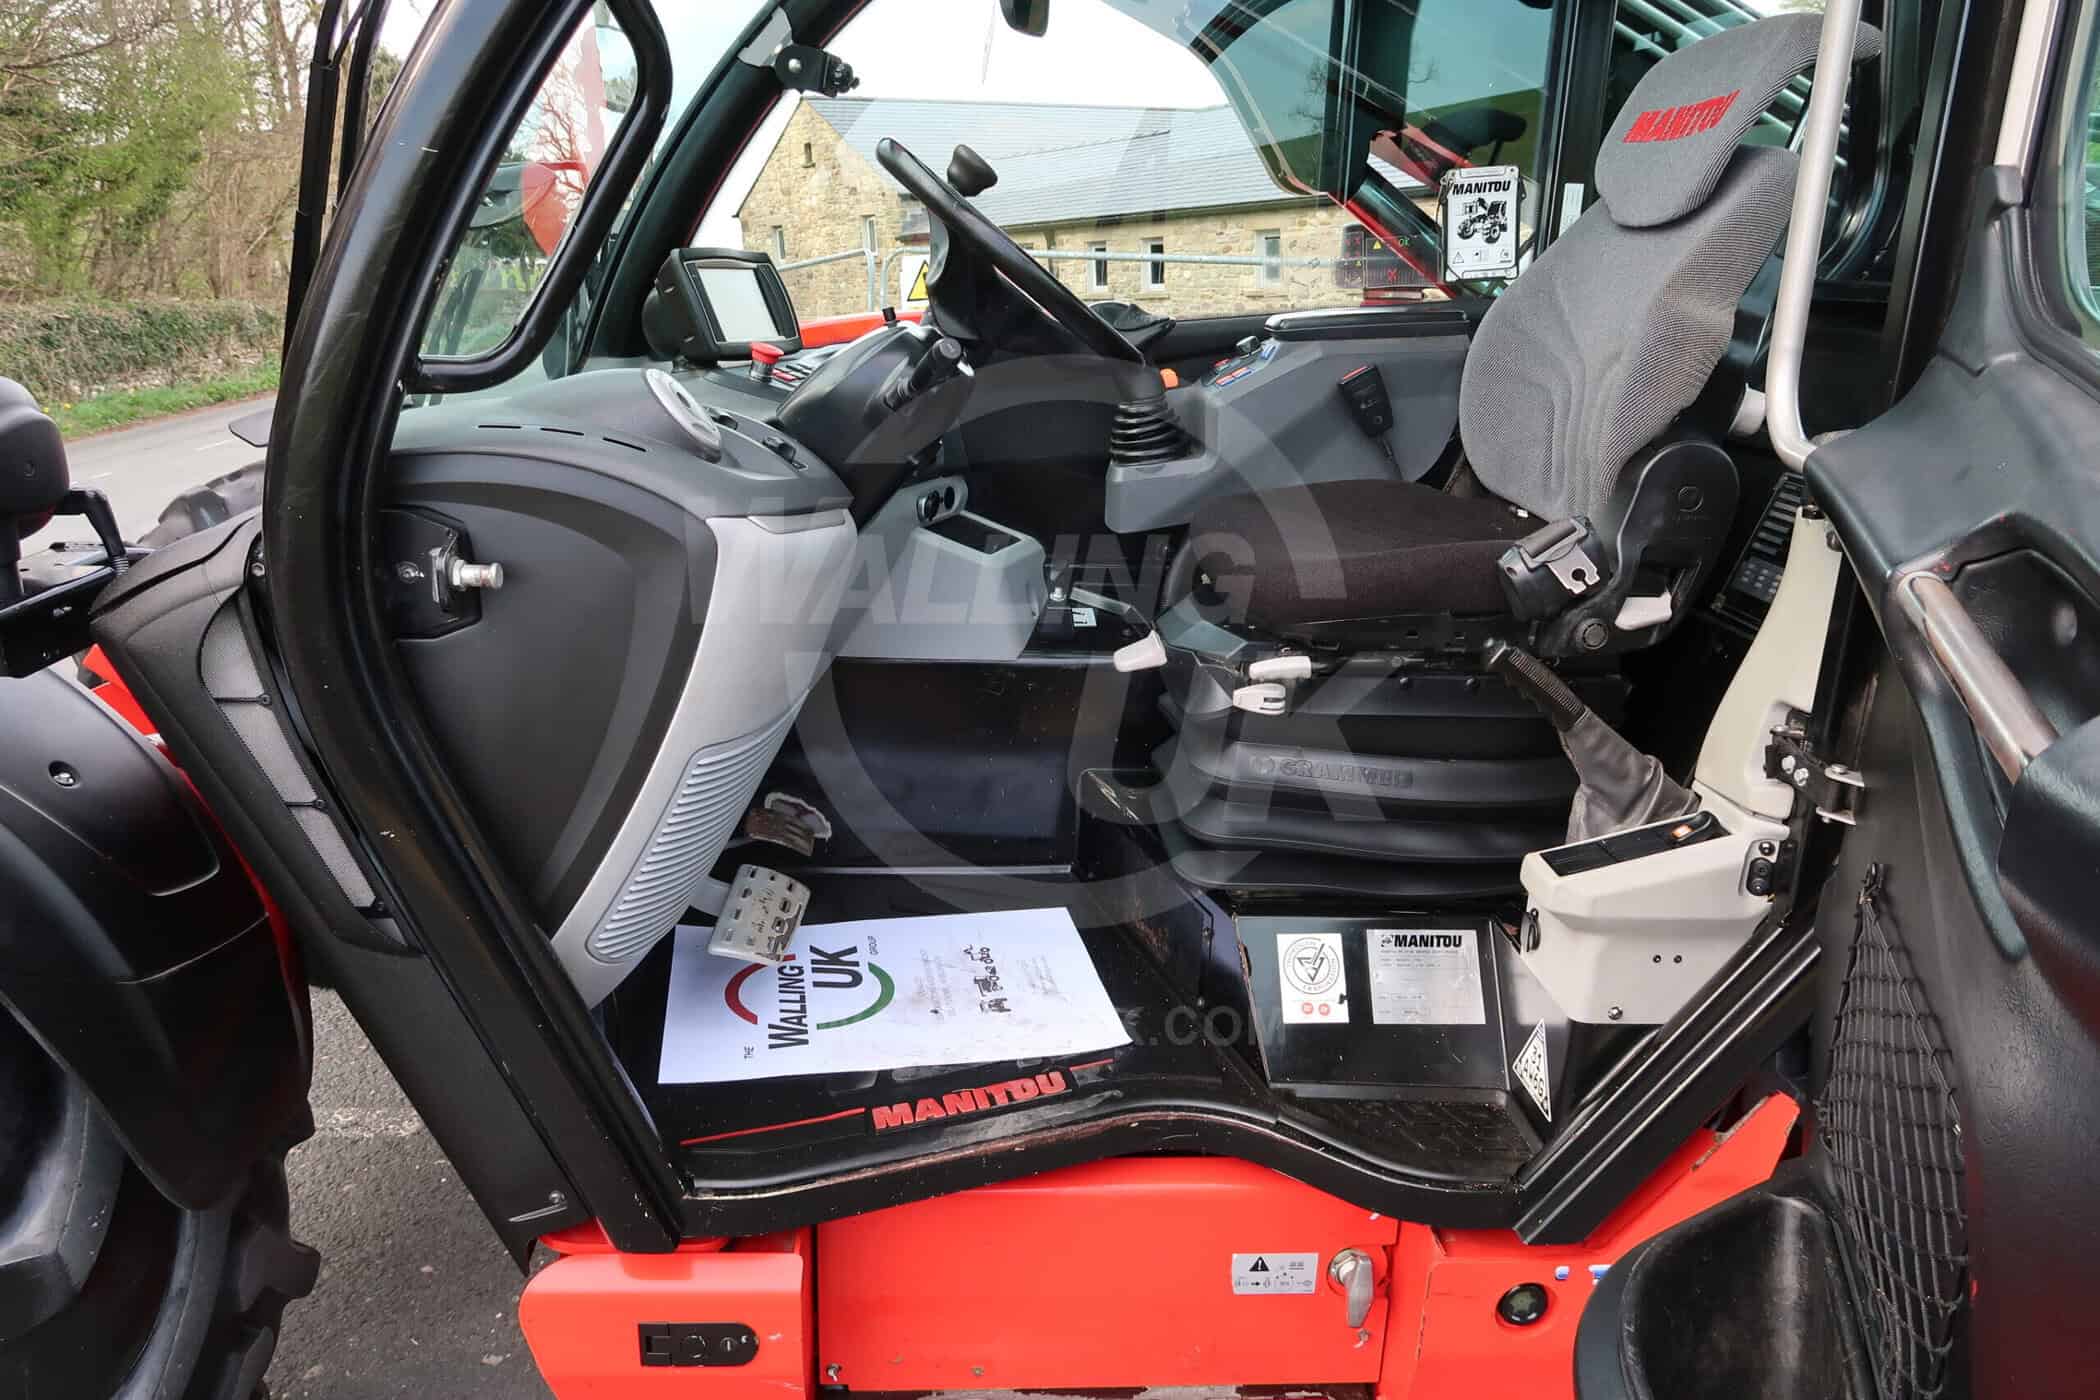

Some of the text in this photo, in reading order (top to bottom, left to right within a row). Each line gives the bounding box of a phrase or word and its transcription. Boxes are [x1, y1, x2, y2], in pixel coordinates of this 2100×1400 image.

[1623, 89, 1741, 143] MANITOU
[1452, 180, 1511, 195] MANITOU
[1393, 934, 1463, 948] MANITOU
[809, 944, 863, 988] UK
[767, 964, 809, 1050] WALLING
[872, 1071, 1066, 1130] MANITOU
